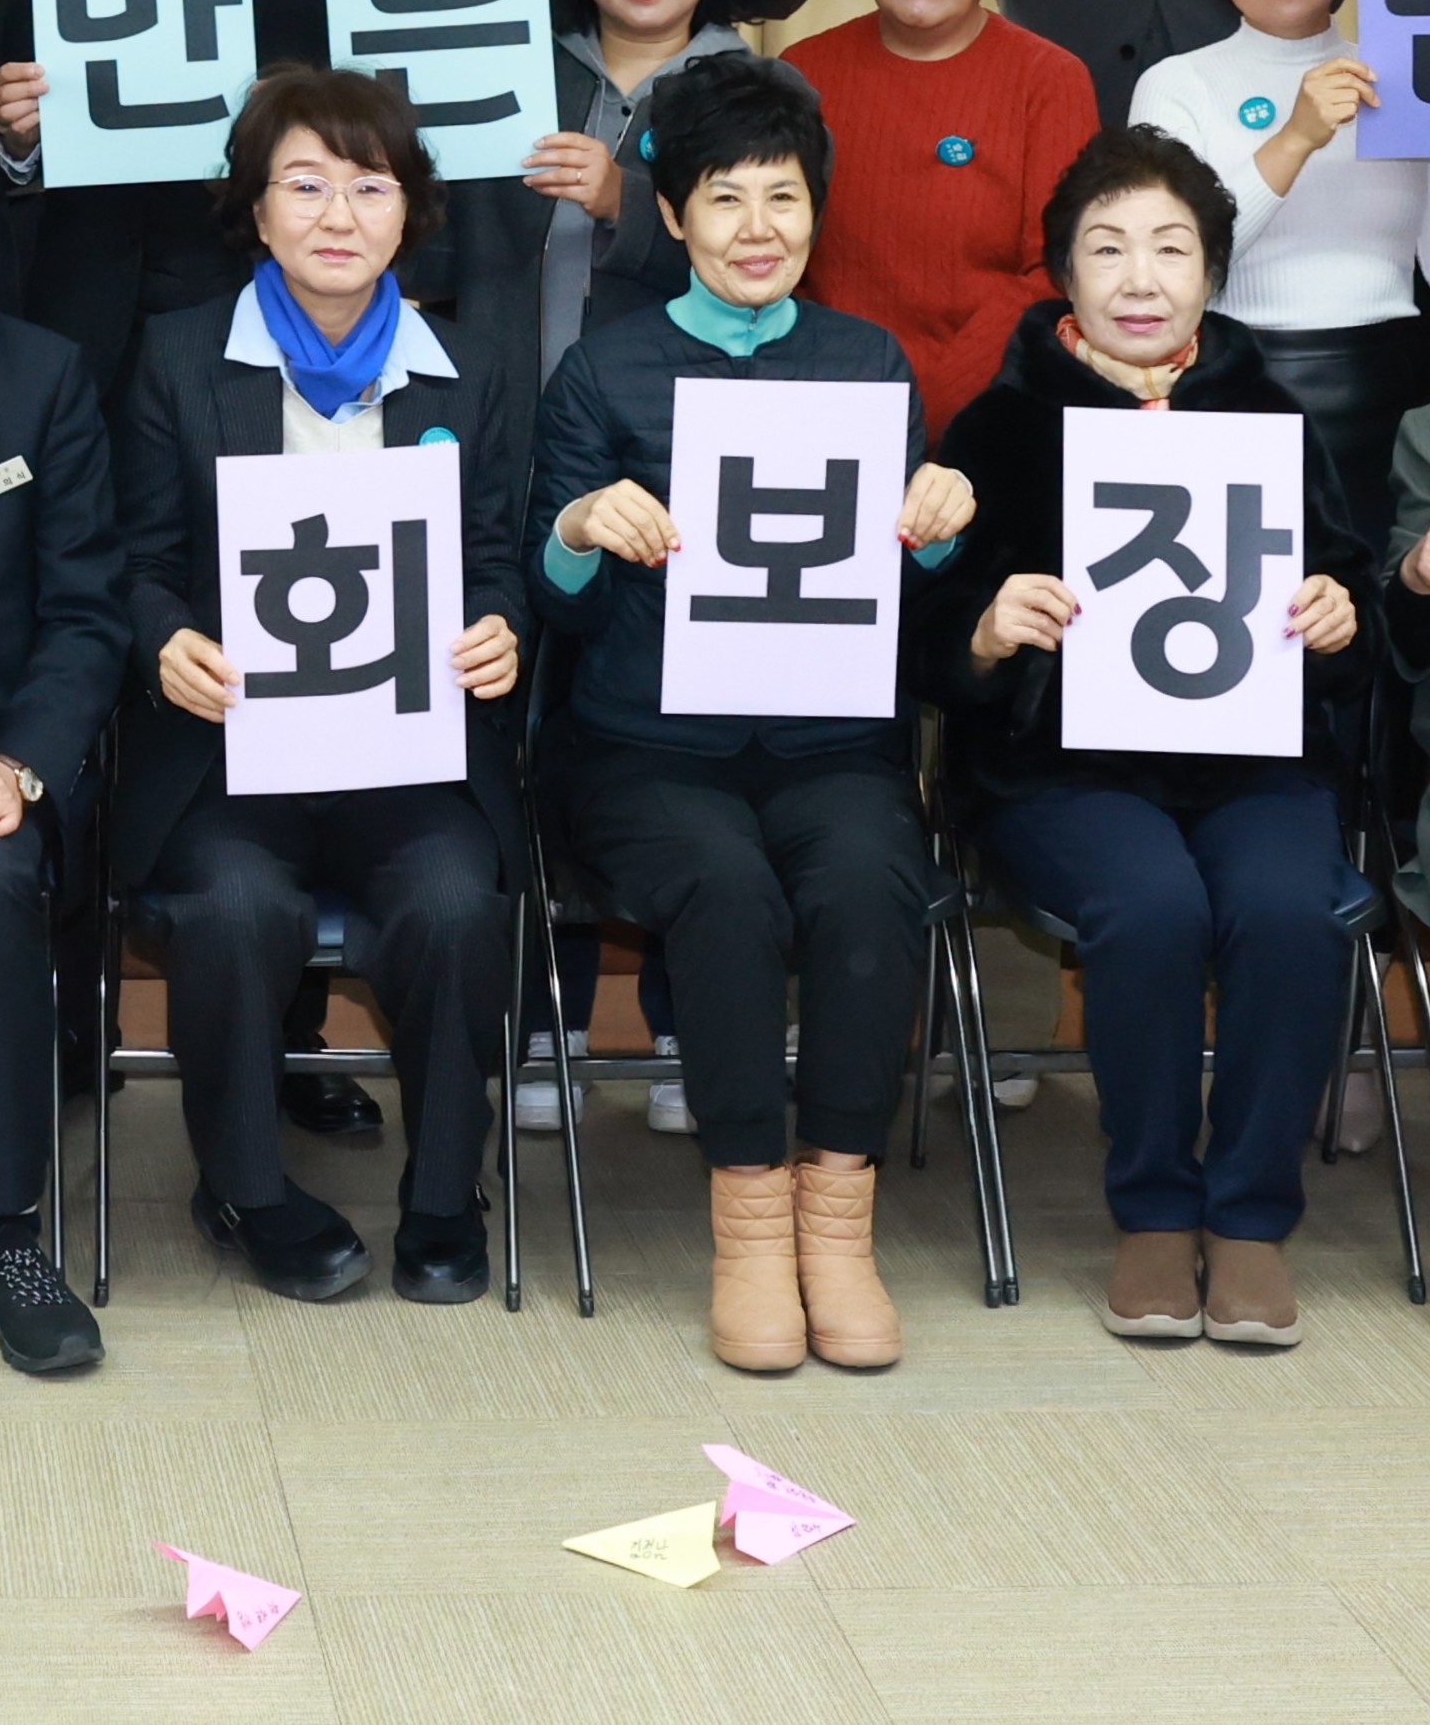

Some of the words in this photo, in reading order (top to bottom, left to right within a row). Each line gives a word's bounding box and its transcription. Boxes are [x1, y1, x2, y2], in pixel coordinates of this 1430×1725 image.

[241, 514, 429, 713] 회
[690, 457, 876, 624] 보
[1086, 482, 1292, 700] 장
